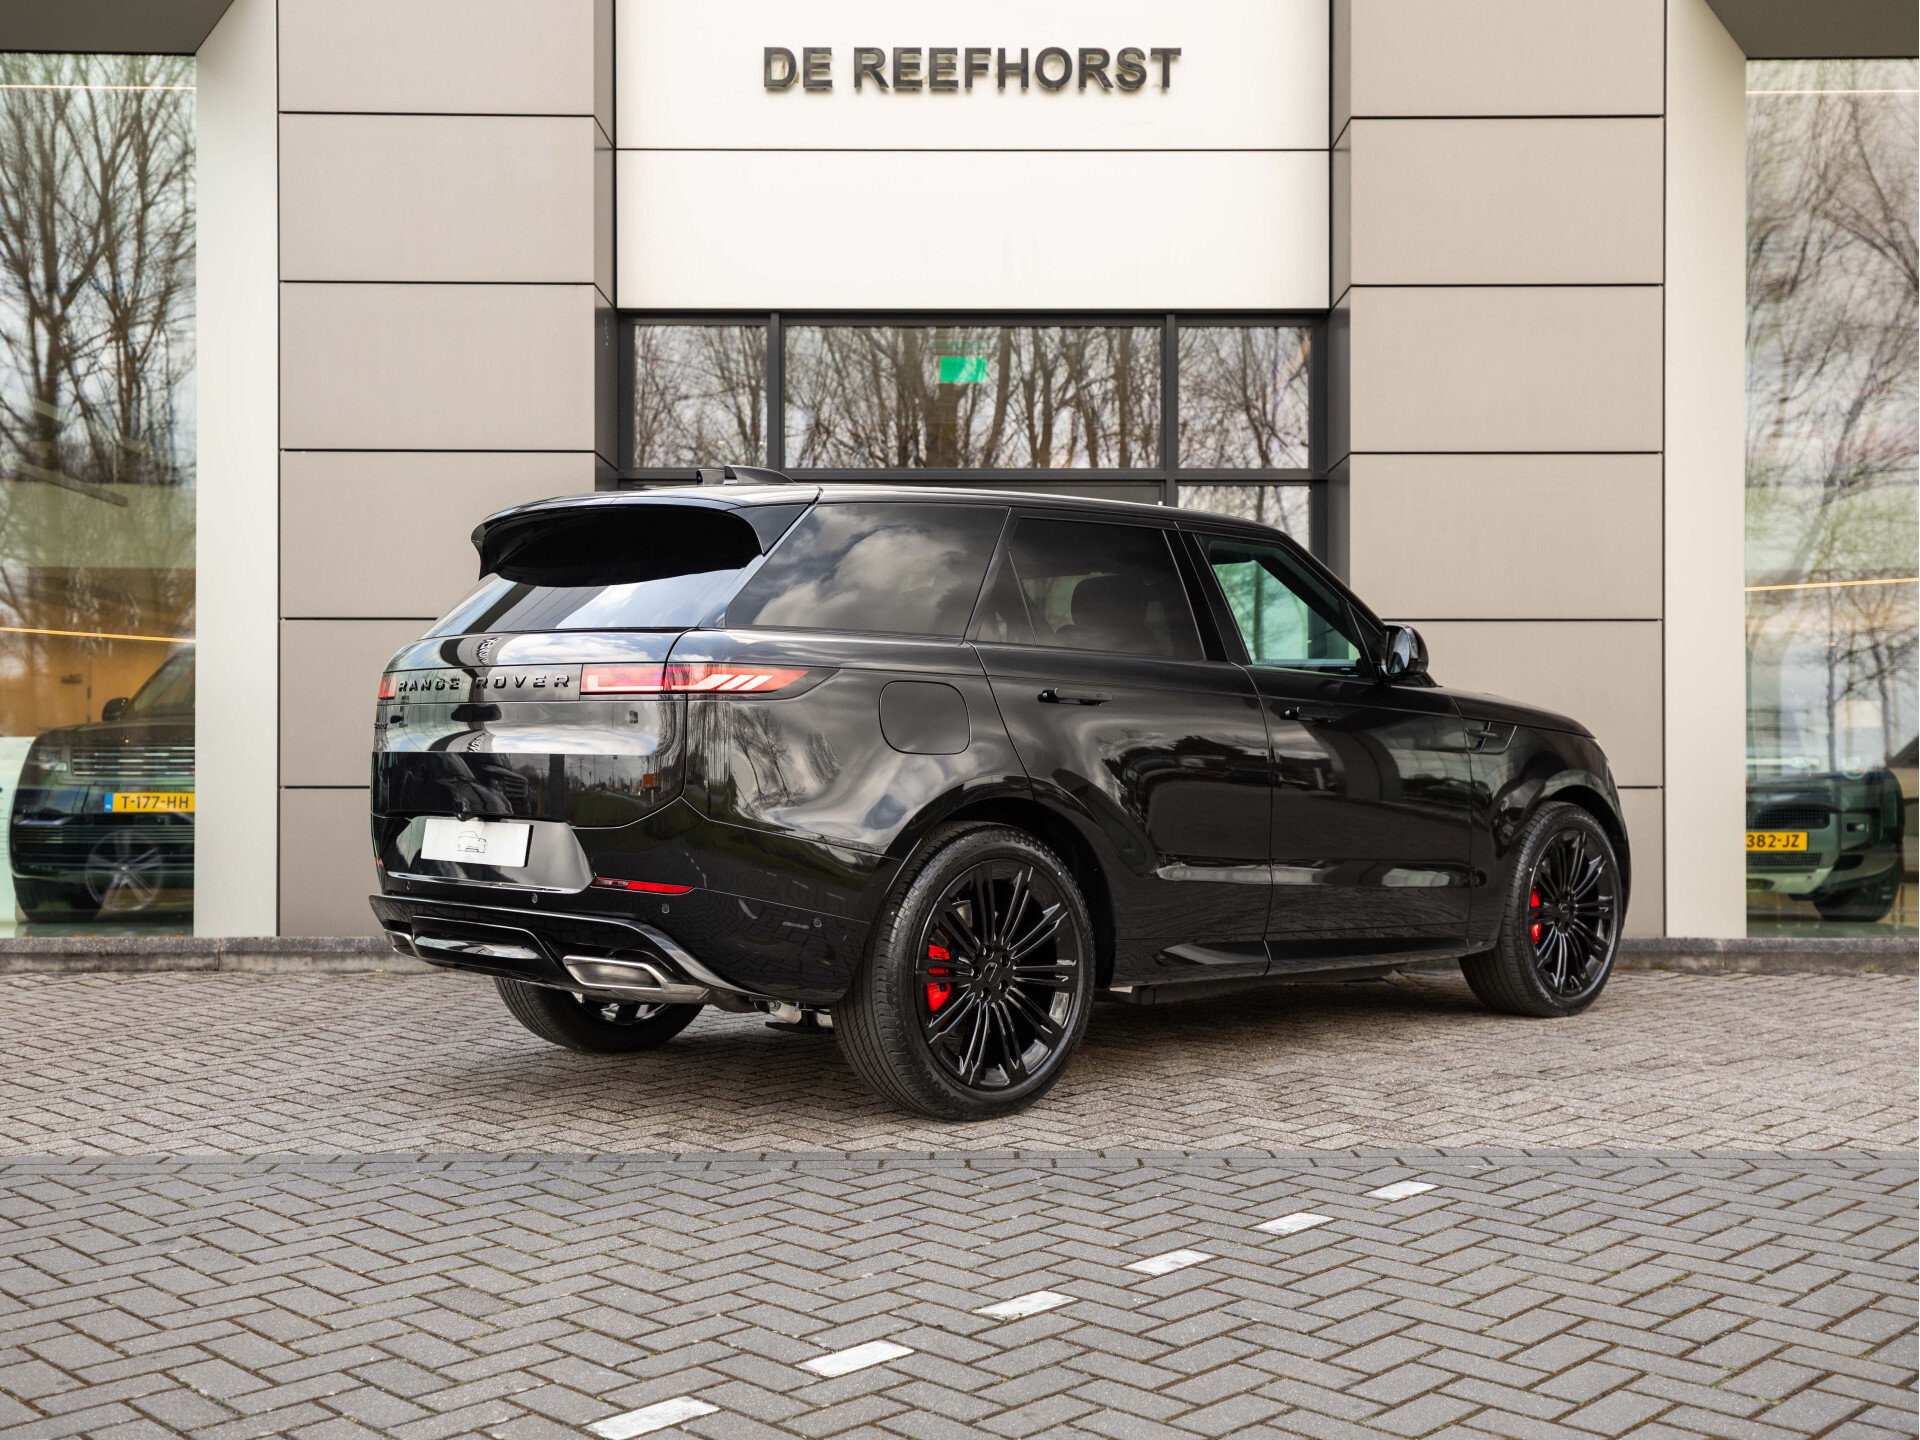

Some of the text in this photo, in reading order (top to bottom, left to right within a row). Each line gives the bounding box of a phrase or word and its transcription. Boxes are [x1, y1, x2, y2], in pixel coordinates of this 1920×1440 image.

[764, 47, 1182, 91] DE REEFHORST
[399, 675, 570, 693] RANGE ROVER
[121, 796, 189, 809] T-177-HH
[1746, 834, 1800, 848] 382-JZ
